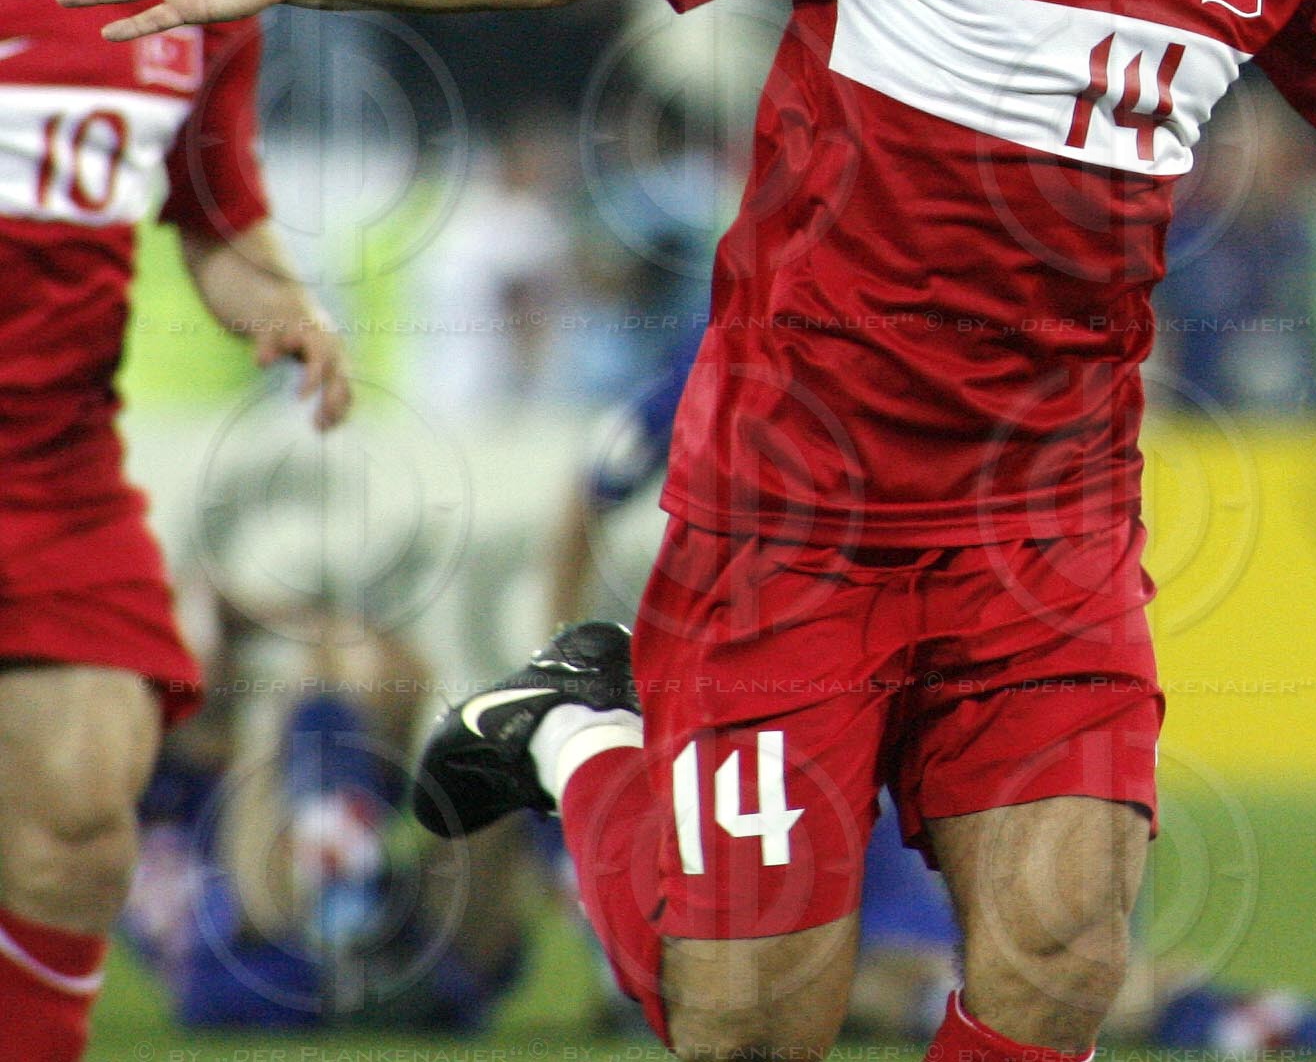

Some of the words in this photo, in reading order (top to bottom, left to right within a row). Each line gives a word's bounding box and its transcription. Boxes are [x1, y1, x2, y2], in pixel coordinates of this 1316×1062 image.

[1064, 31, 1184, 161] 14
[35, 108, 131, 216] 10
[672, 729, 805, 876] 14
